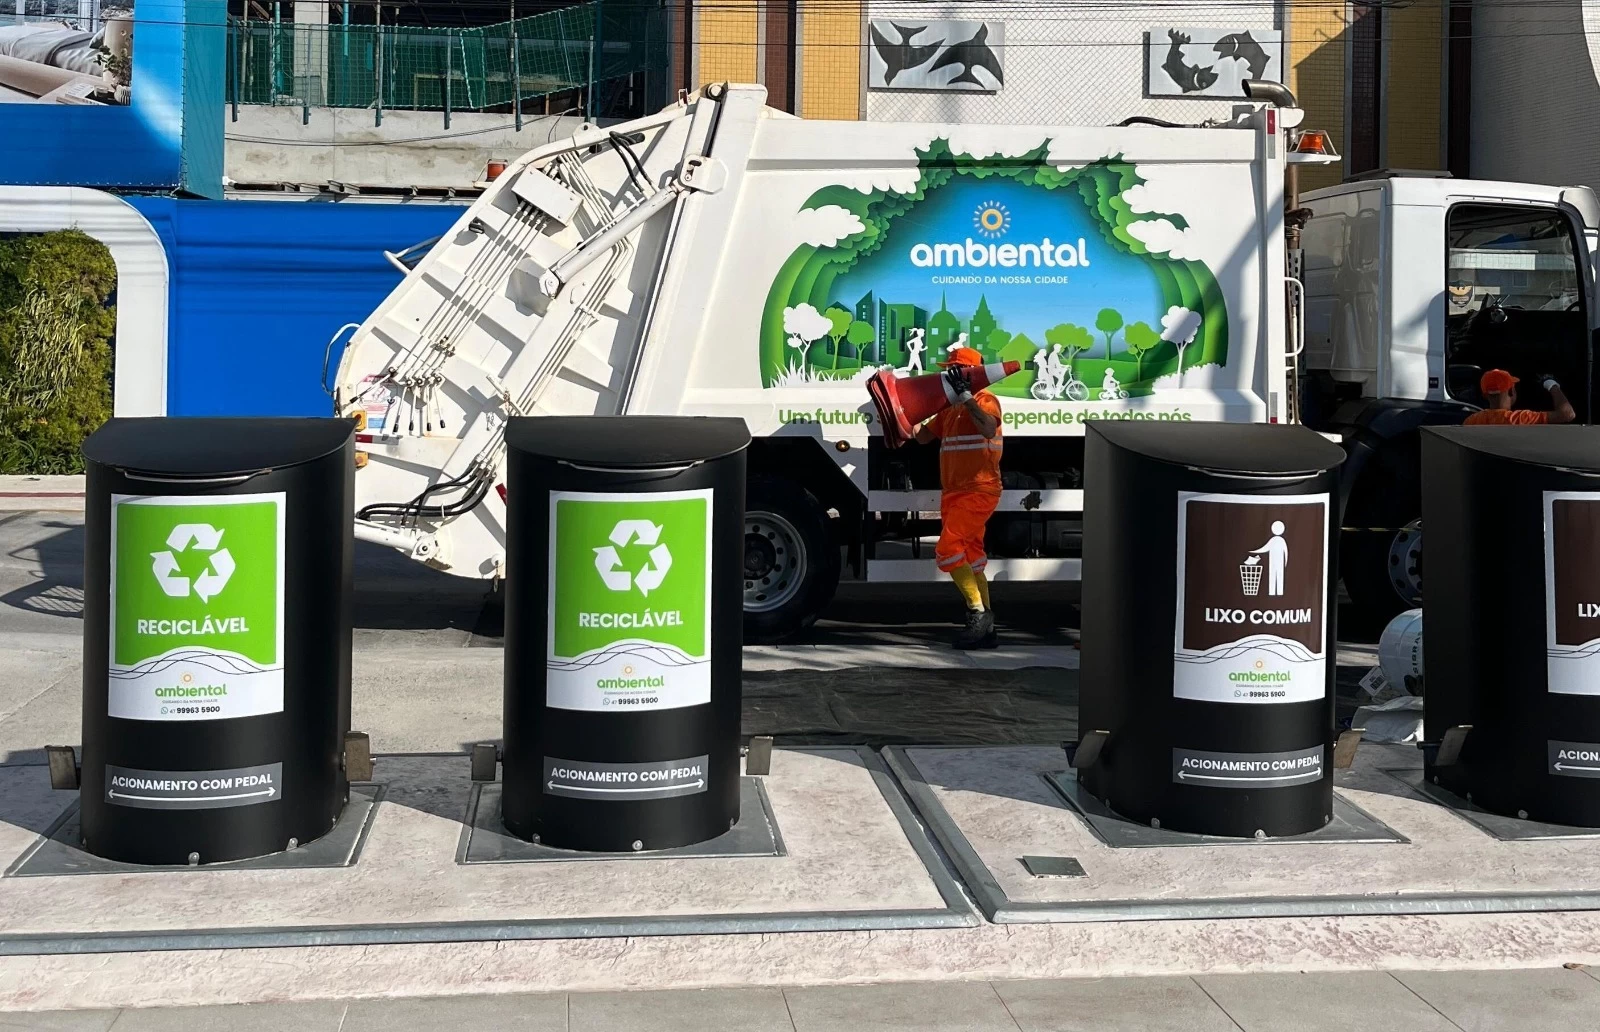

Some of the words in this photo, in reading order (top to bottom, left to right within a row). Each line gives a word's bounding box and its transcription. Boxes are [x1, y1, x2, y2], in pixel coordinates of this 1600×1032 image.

[910, 237, 1090, 267] ambiental
[931, 275, 982, 284] CUIDANDO
[984, 275, 998, 284] DA
[1000, 275, 1032, 284] NOSSA
[1034, 275, 1069, 284] CIDADE
[779, 409, 812, 424] Um
[815, 408, 873, 424] futuro
[1002, 409, 1074, 429] epende
[1076, 409, 1100, 424] de
[1103, 408, 1156, 421] todos
[137, 615, 250, 635] RECICLÁVEL
[579, 608, 684, 628] RECICLÁVEL
[1205, 607, 1246, 624] LIXO
[1250, 608, 1312, 625] COMUM
[596, 675, 664, 689] ambiental
[1228, 670, 1291, 682] ambiental
[155, 683, 228, 697] ambiental
[201, 705, 221, 713] 5900
[640, 696, 659, 704] 5900
[1182, 757, 1270, 772] ACIONAMENTO
[1271, 759, 1296, 770] COM
[1297, 754, 1321, 769] PEDAL
[1557, 749, 1600, 762] ACION
[111, 775, 198, 791] ACIONAMENTO
[200, 778, 233, 790] COM
[235, 773, 273, 788] PEDAL
[551, 767, 638, 783] ACIONAMENTO
[640, 770, 669, 781] COM
[670, 765, 702, 780] PEDAL
